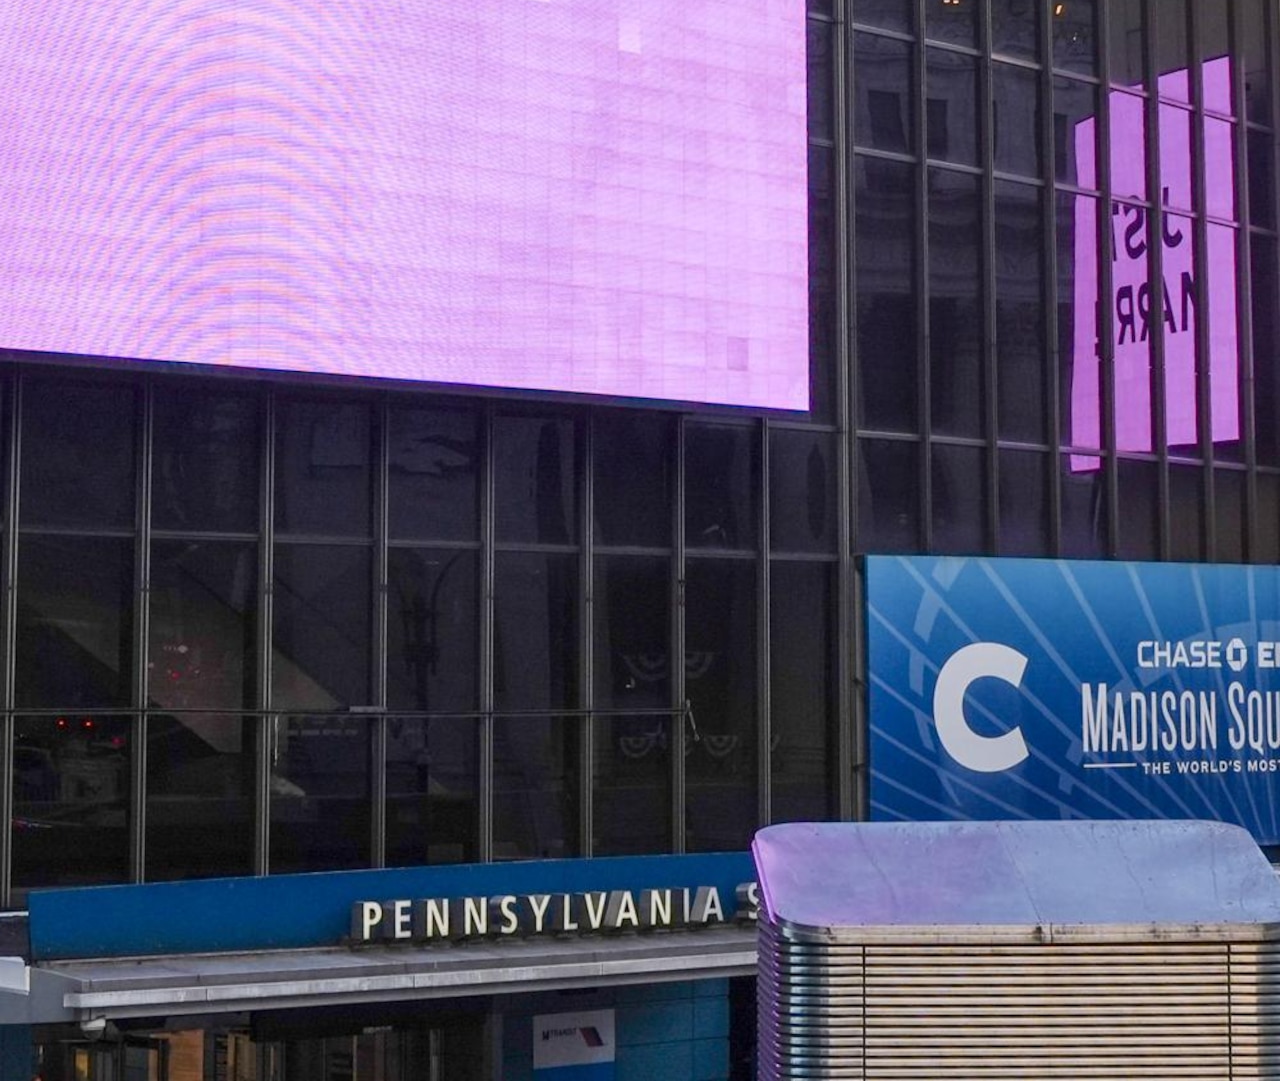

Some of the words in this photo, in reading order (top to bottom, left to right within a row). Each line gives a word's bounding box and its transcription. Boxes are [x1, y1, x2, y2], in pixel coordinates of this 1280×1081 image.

[1137, 640, 1221, 668] CHASE
[933, 641, 1030, 773] C
[1081, 681, 1216, 753] MADISON
[1142, 762, 1171, 775] THE
[1177, 760, 1242, 774] WORLD'S
[362, 886, 724, 941] PENNSYLVANIA
